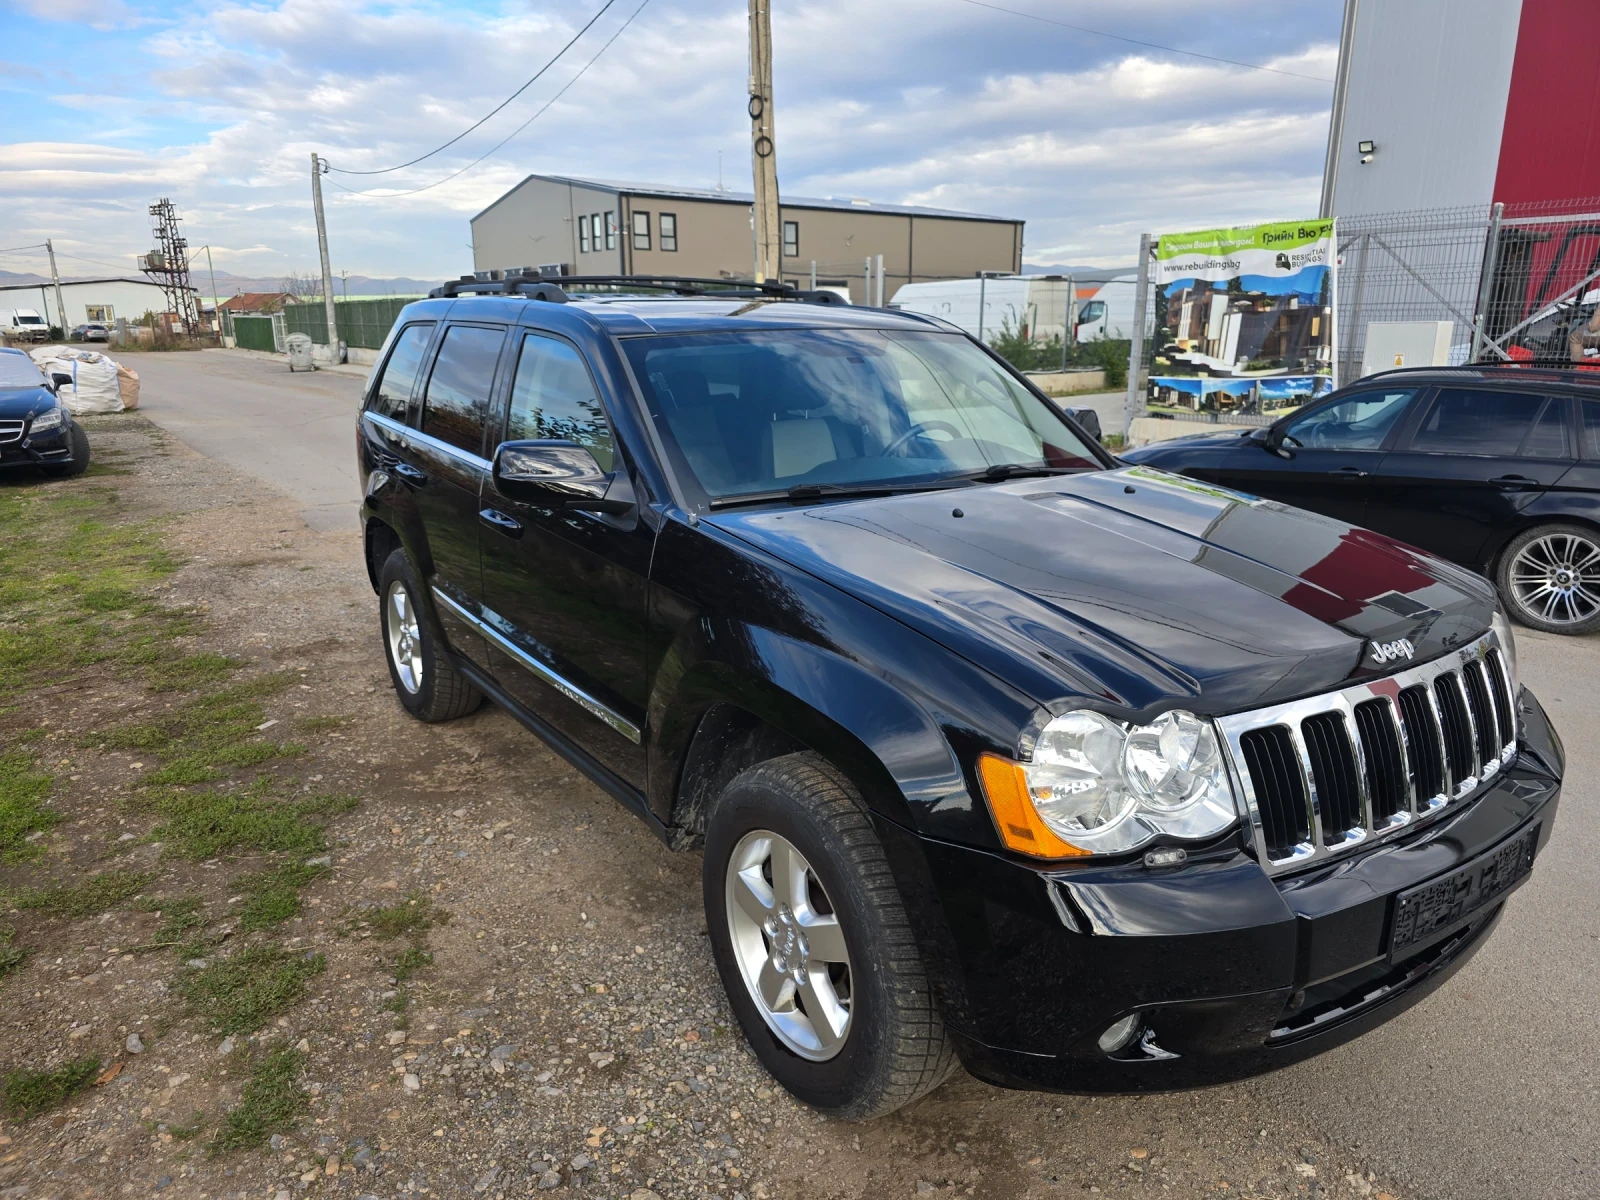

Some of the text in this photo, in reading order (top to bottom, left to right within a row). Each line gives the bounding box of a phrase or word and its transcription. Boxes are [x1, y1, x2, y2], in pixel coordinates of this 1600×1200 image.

[1262, 230, 1294, 245] Грийн
[1298, 227, 1317, 239] Вю
[1164, 260, 1241, 272] www.rebuildingsbg
[1371, 638, 1415, 664] Jeep
